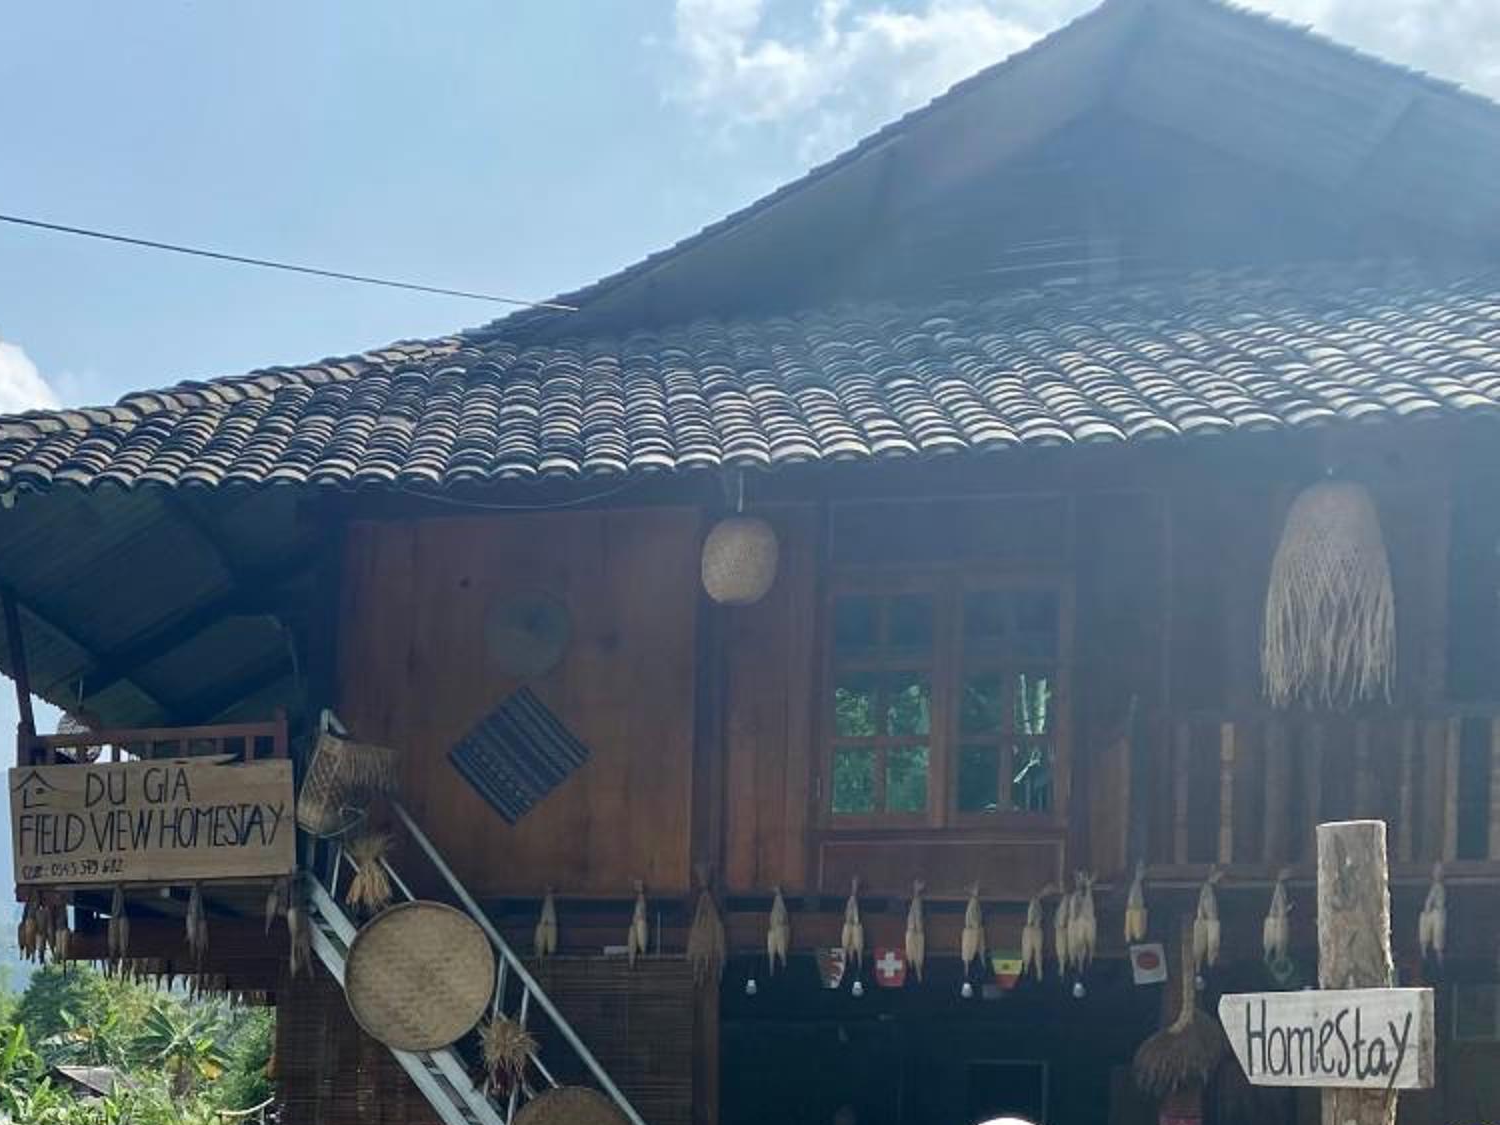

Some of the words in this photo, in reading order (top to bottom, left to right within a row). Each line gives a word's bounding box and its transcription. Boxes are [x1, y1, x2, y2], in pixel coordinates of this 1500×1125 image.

[85, 772, 127, 809] DU
[19, 813, 86, 857] FIELD
[90, 808, 154, 852] VIEW
[159, 803, 285, 850] HOMESTAY
